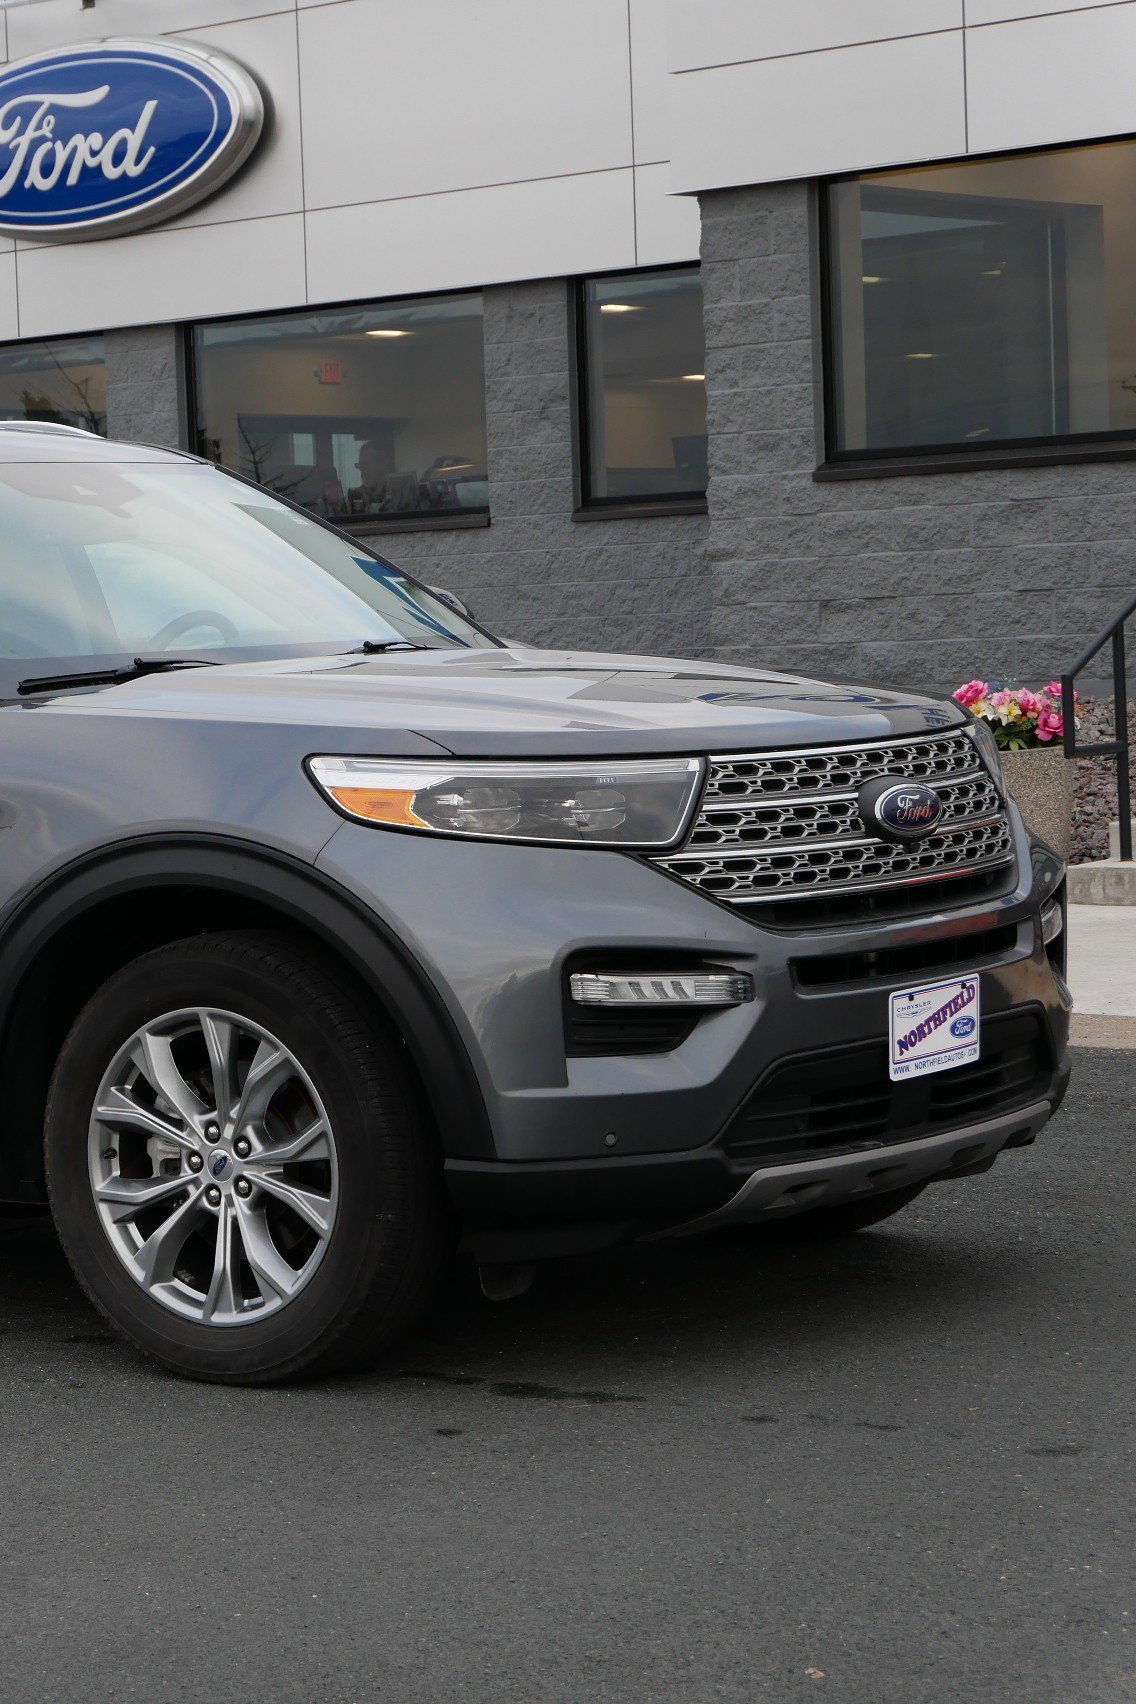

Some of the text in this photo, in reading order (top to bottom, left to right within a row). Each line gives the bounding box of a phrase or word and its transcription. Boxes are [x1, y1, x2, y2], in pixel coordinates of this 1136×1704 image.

[897, 794, 933, 823] Ford
[896, 1000, 932, 1013] CHRYSLER
[896, 983, 976, 1056] NORTHFIELD
[954, 1018, 972, 1034] Ford
